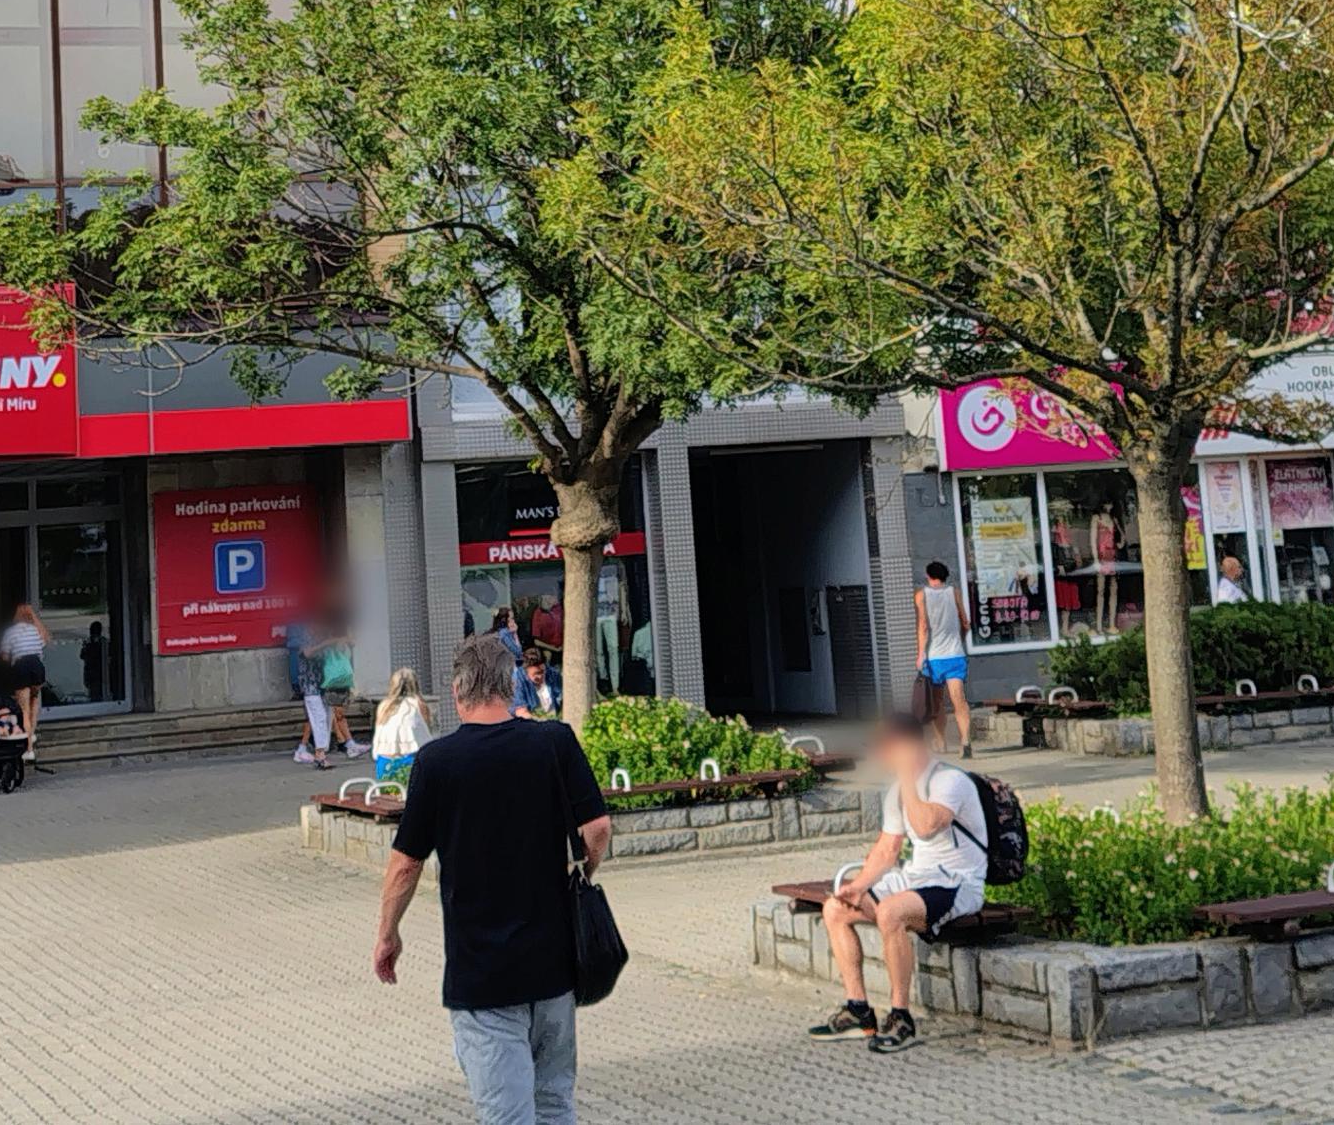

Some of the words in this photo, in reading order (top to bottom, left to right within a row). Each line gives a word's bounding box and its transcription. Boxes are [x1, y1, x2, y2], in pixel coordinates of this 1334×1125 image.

[6, 396, 37, 413] Míru
[175, 499, 226, 517] Hodina
[229, 495, 300, 515] parkování
[212, 518, 267, 534] zdarma
[228, 548, 255, 585] P
[182, 602, 199, 618] při
[200, 600, 241, 616] nákupu
[242, 598, 264, 611] nad
